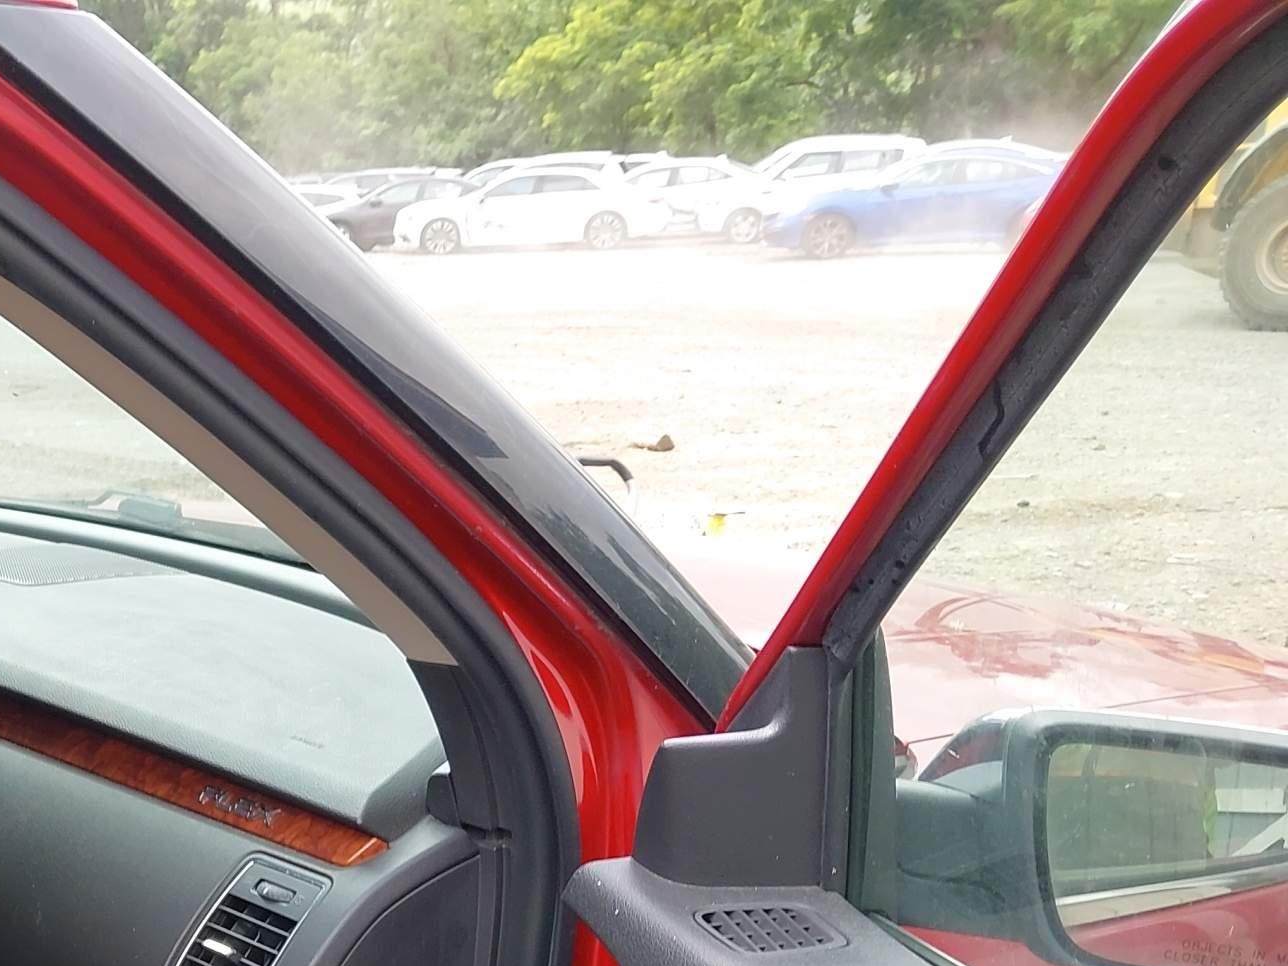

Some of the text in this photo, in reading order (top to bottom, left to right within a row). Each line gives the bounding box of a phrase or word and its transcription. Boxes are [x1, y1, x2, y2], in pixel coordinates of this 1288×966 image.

[198, 785, 282, 829] FLEX
[1182, 939, 1243, 959] OBJECTS
[1253, 950, 1267, 961] IN
